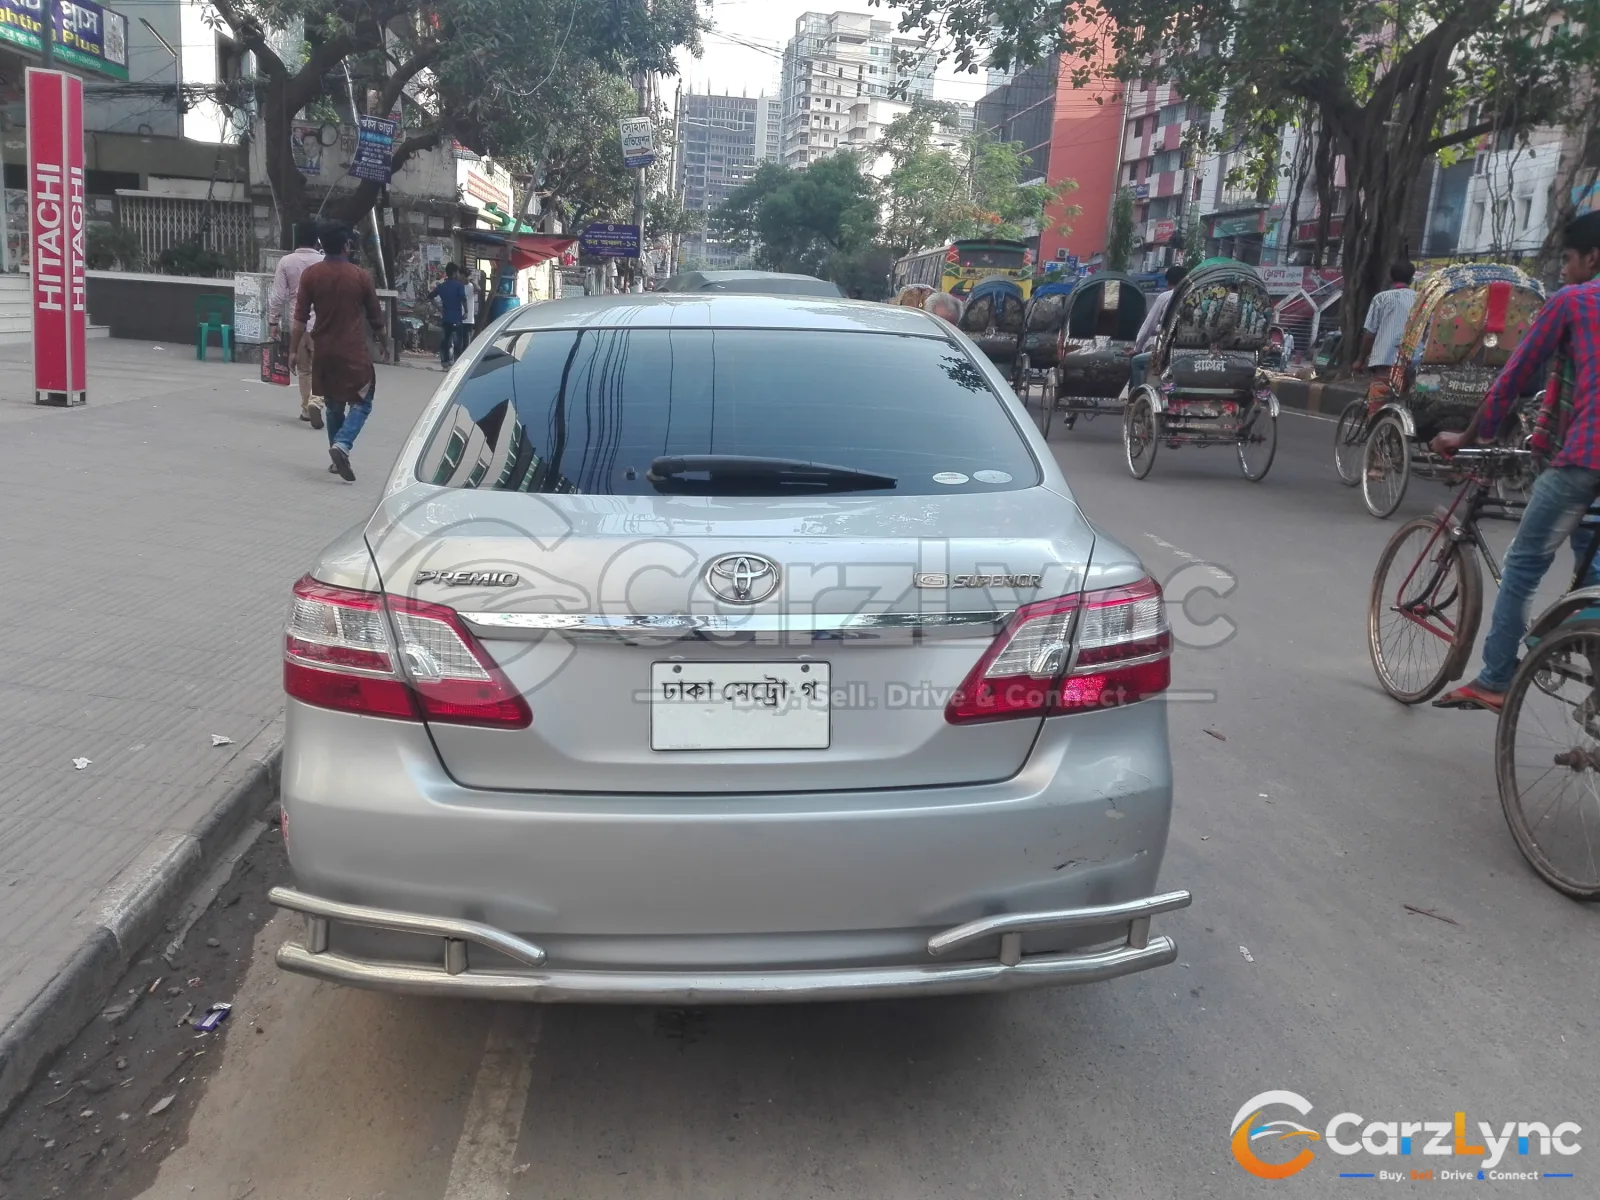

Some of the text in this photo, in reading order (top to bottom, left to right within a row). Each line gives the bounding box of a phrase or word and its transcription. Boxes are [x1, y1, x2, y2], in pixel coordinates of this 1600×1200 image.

[62, 29, 100, 54] Plus
[378, 121, 394, 135] ভাড়া
[37, 163, 62, 311] HITACHI
[71, 166, 84, 311] HITACHI
[414, 570, 520, 588] PREMIO
[951, 573, 1043, 588] SUPERIOR
[662, 678, 714, 701] ঢাকা
